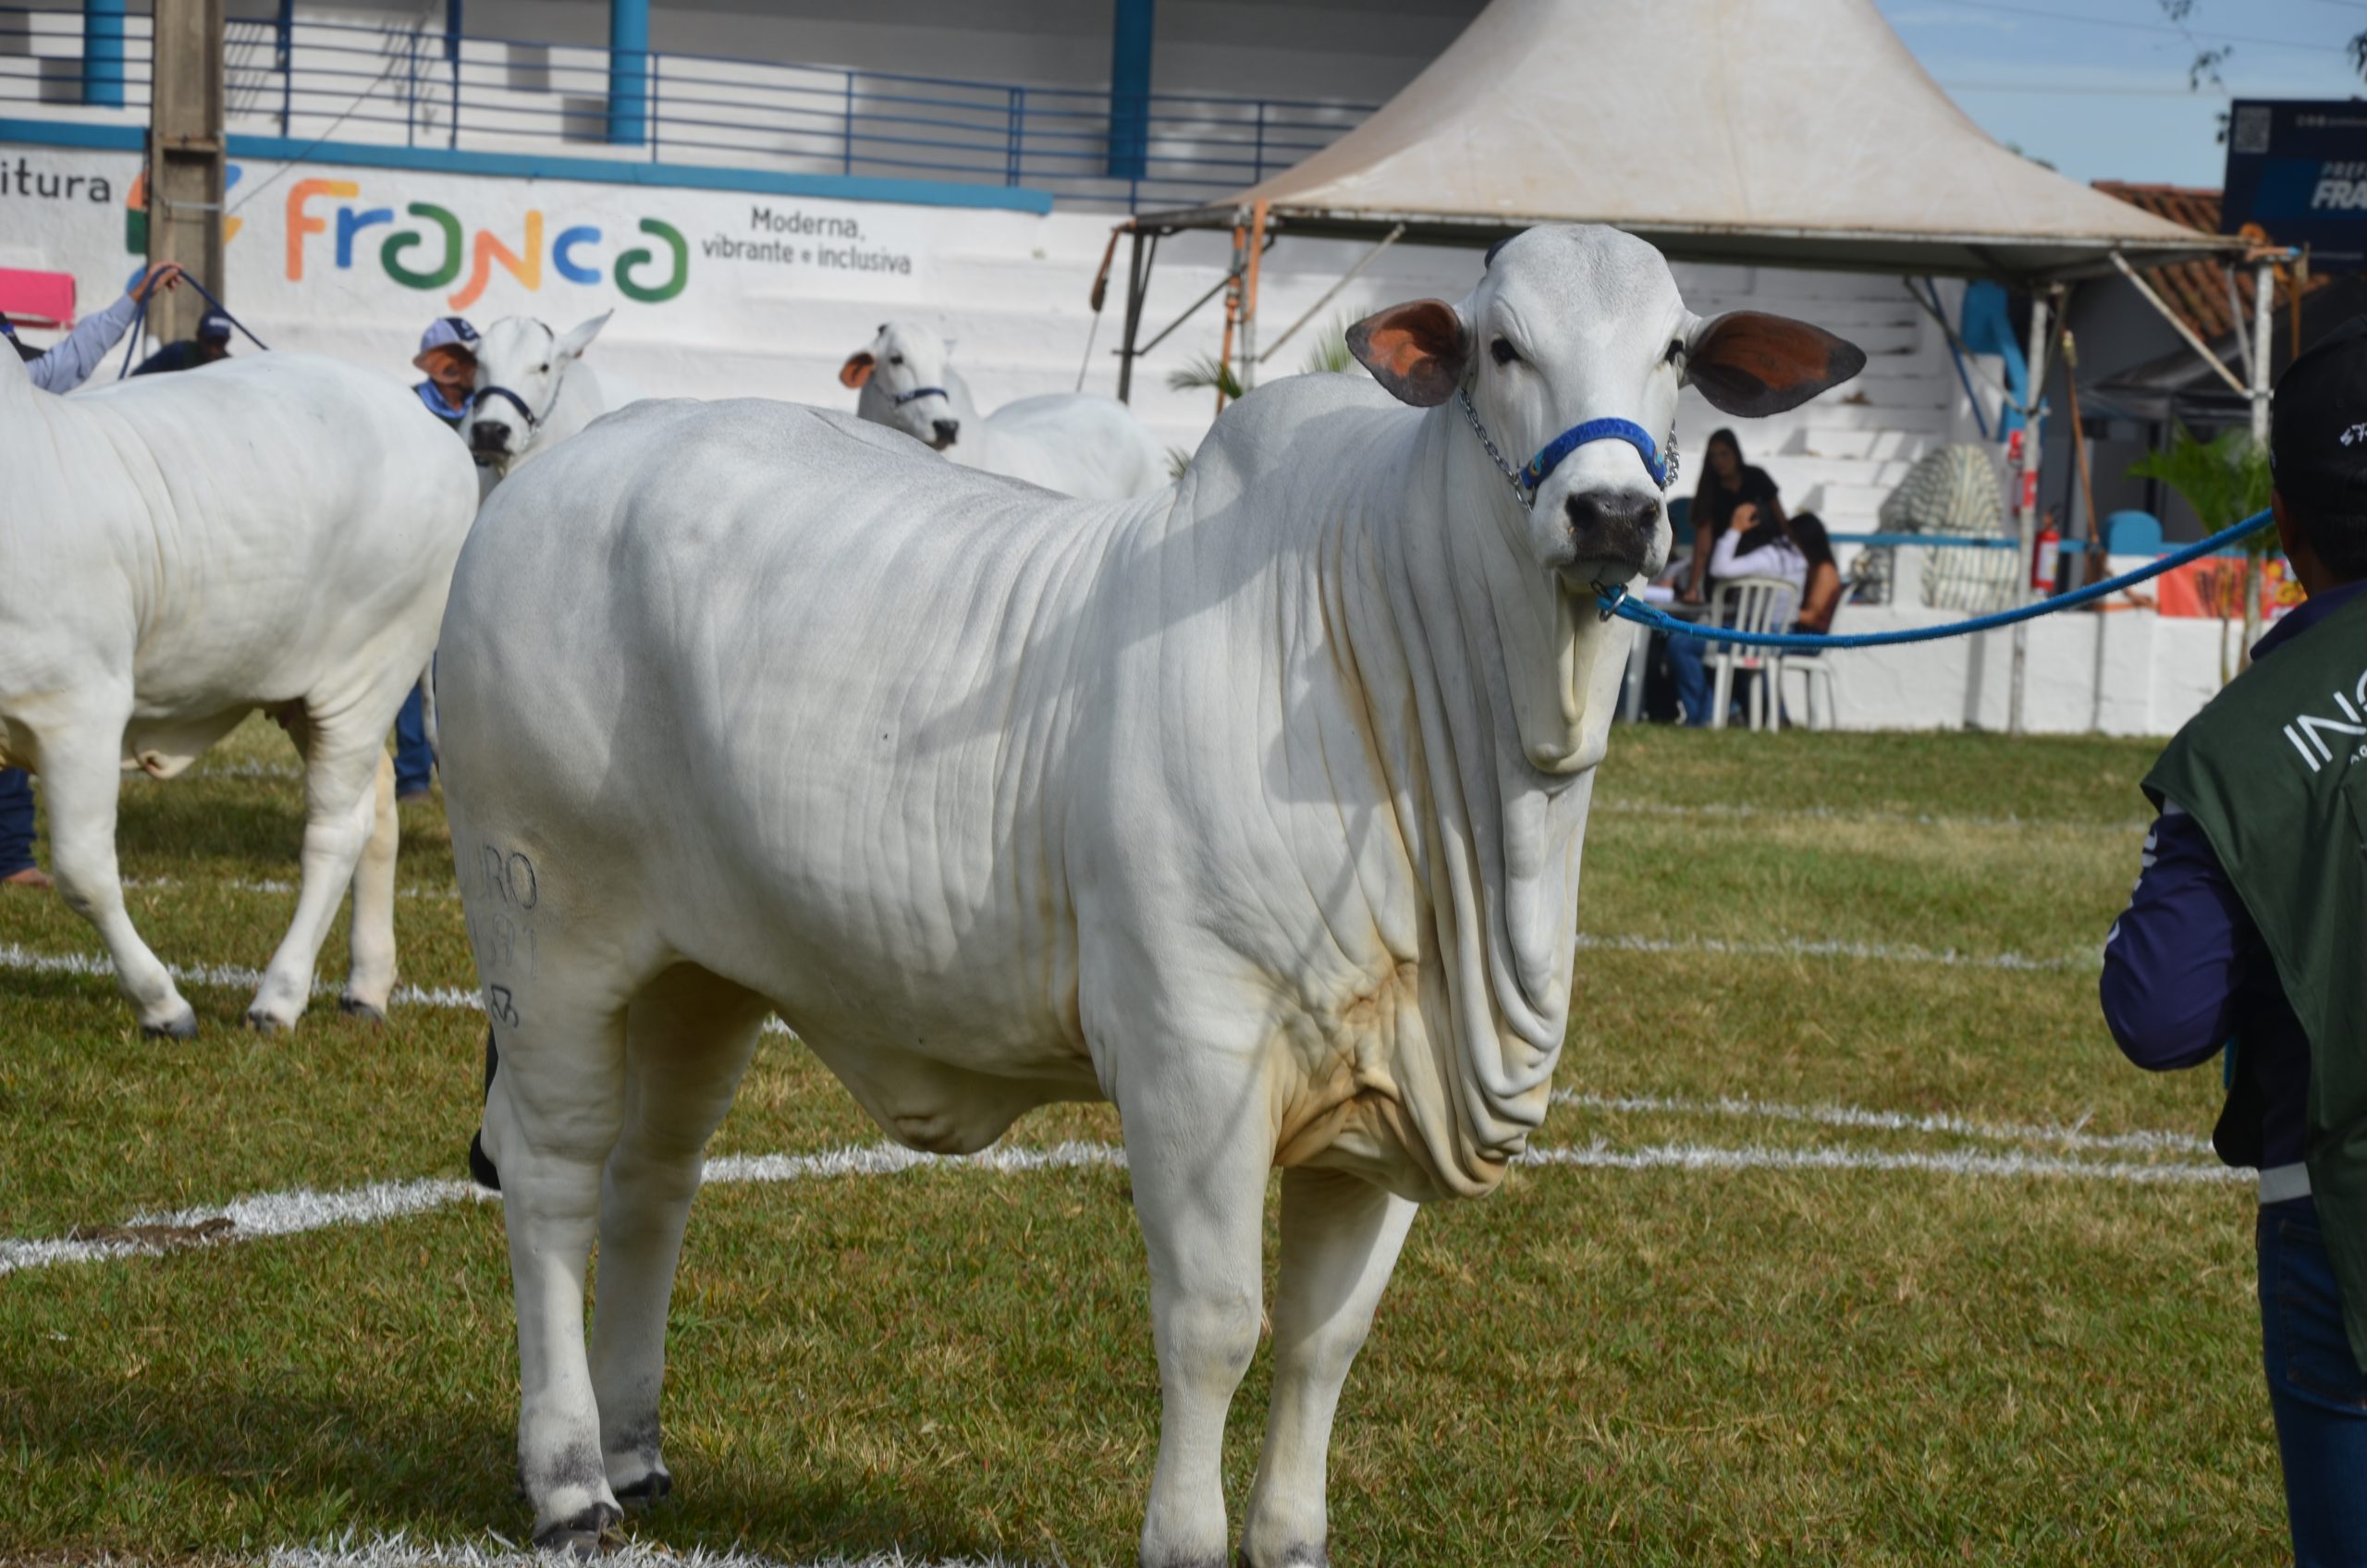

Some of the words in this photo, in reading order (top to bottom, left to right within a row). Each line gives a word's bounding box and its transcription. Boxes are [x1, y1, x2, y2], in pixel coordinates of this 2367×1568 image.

[2, 157, 111, 203] itura
[751, 206, 866, 241] Moderna,
[702, 234, 794, 264] vibrante
[817, 241, 912, 276] inclusiva
